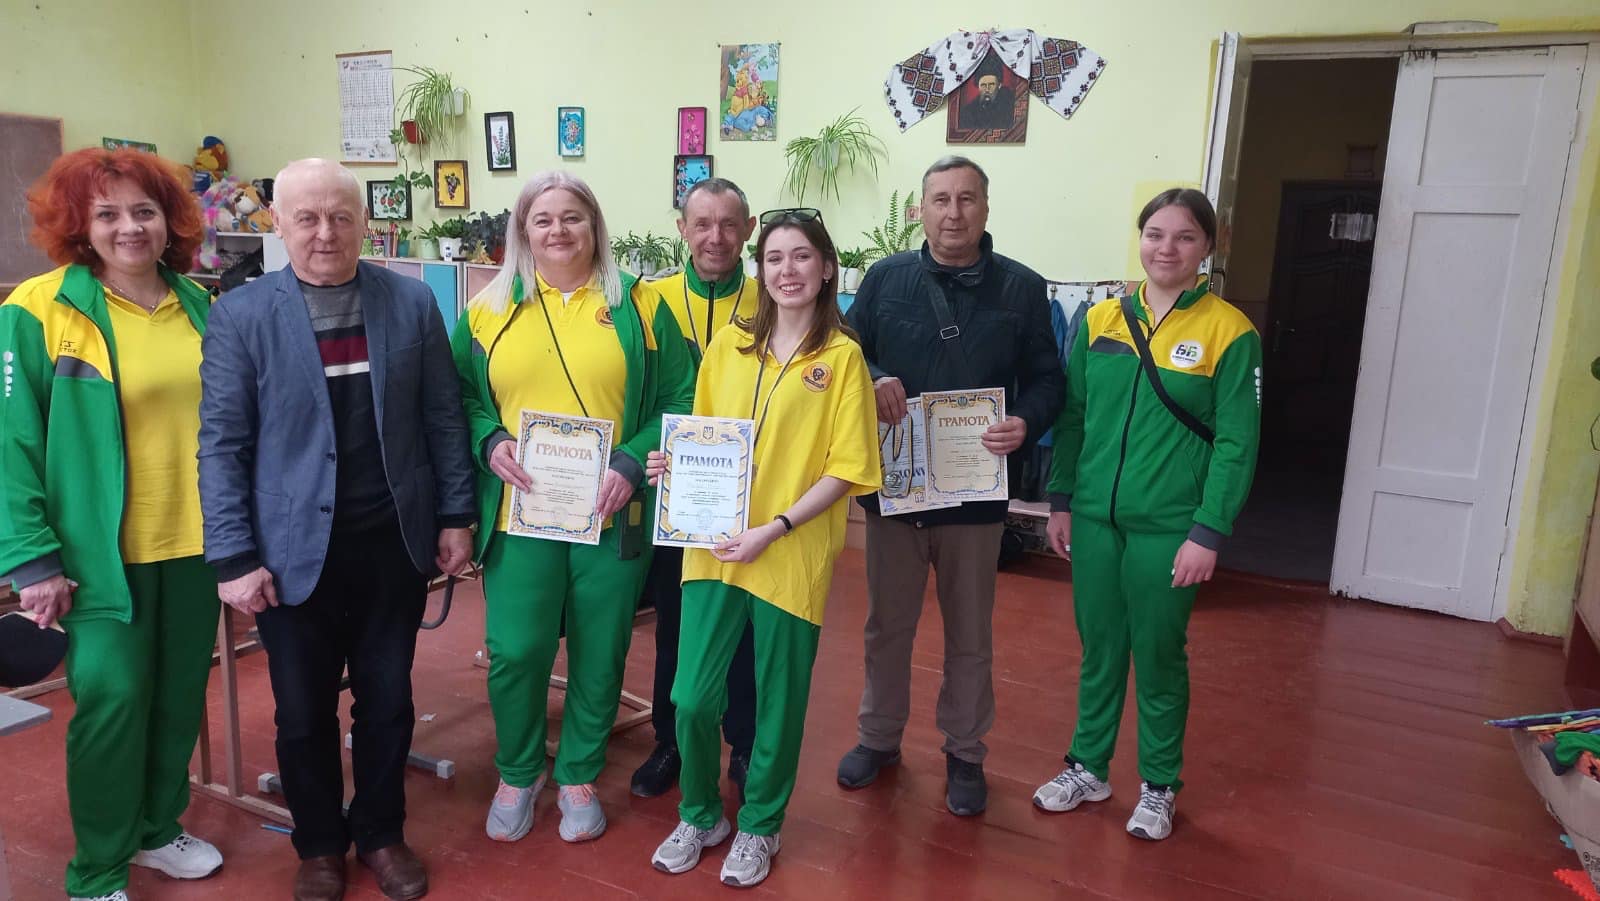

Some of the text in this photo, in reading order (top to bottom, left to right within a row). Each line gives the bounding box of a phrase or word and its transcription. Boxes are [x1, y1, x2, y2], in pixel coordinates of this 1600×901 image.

[938, 415, 991, 428] ГРАМОТА
[535, 442, 593, 461] ГРАМОТА
[679, 454, 734, 469] ГРАМОТА
